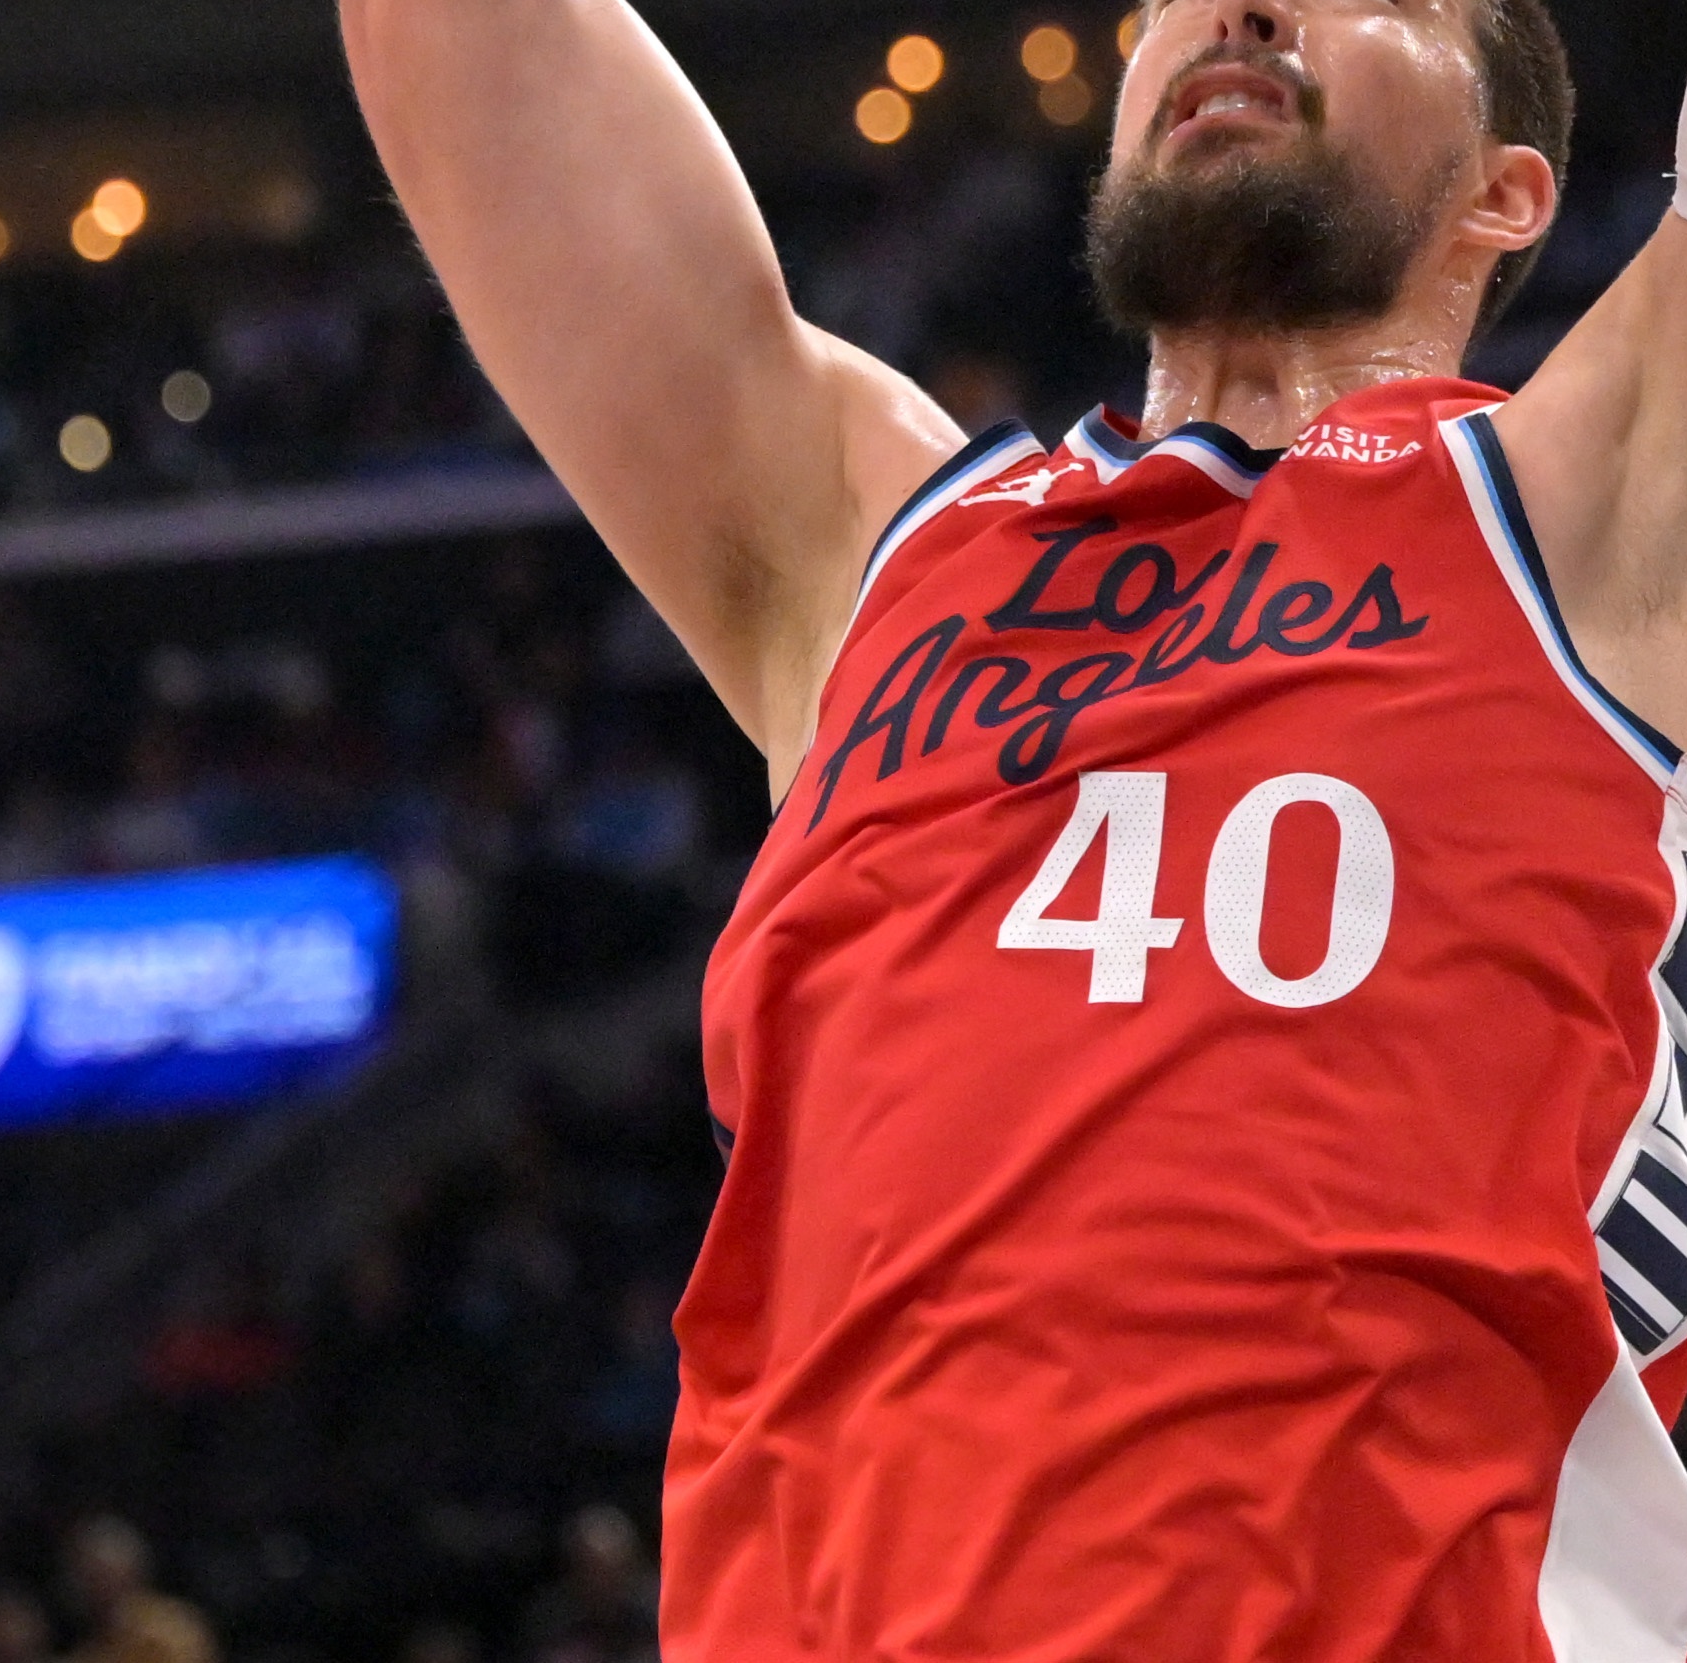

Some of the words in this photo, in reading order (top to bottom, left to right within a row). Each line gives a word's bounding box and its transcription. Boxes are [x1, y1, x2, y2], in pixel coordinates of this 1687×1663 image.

[1278, 440, 1424, 464] WANDA
[983, 513, 1232, 635] Lo
[804, 542, 1431, 838] Angeles
[996, 770, 1395, 1009] 40
